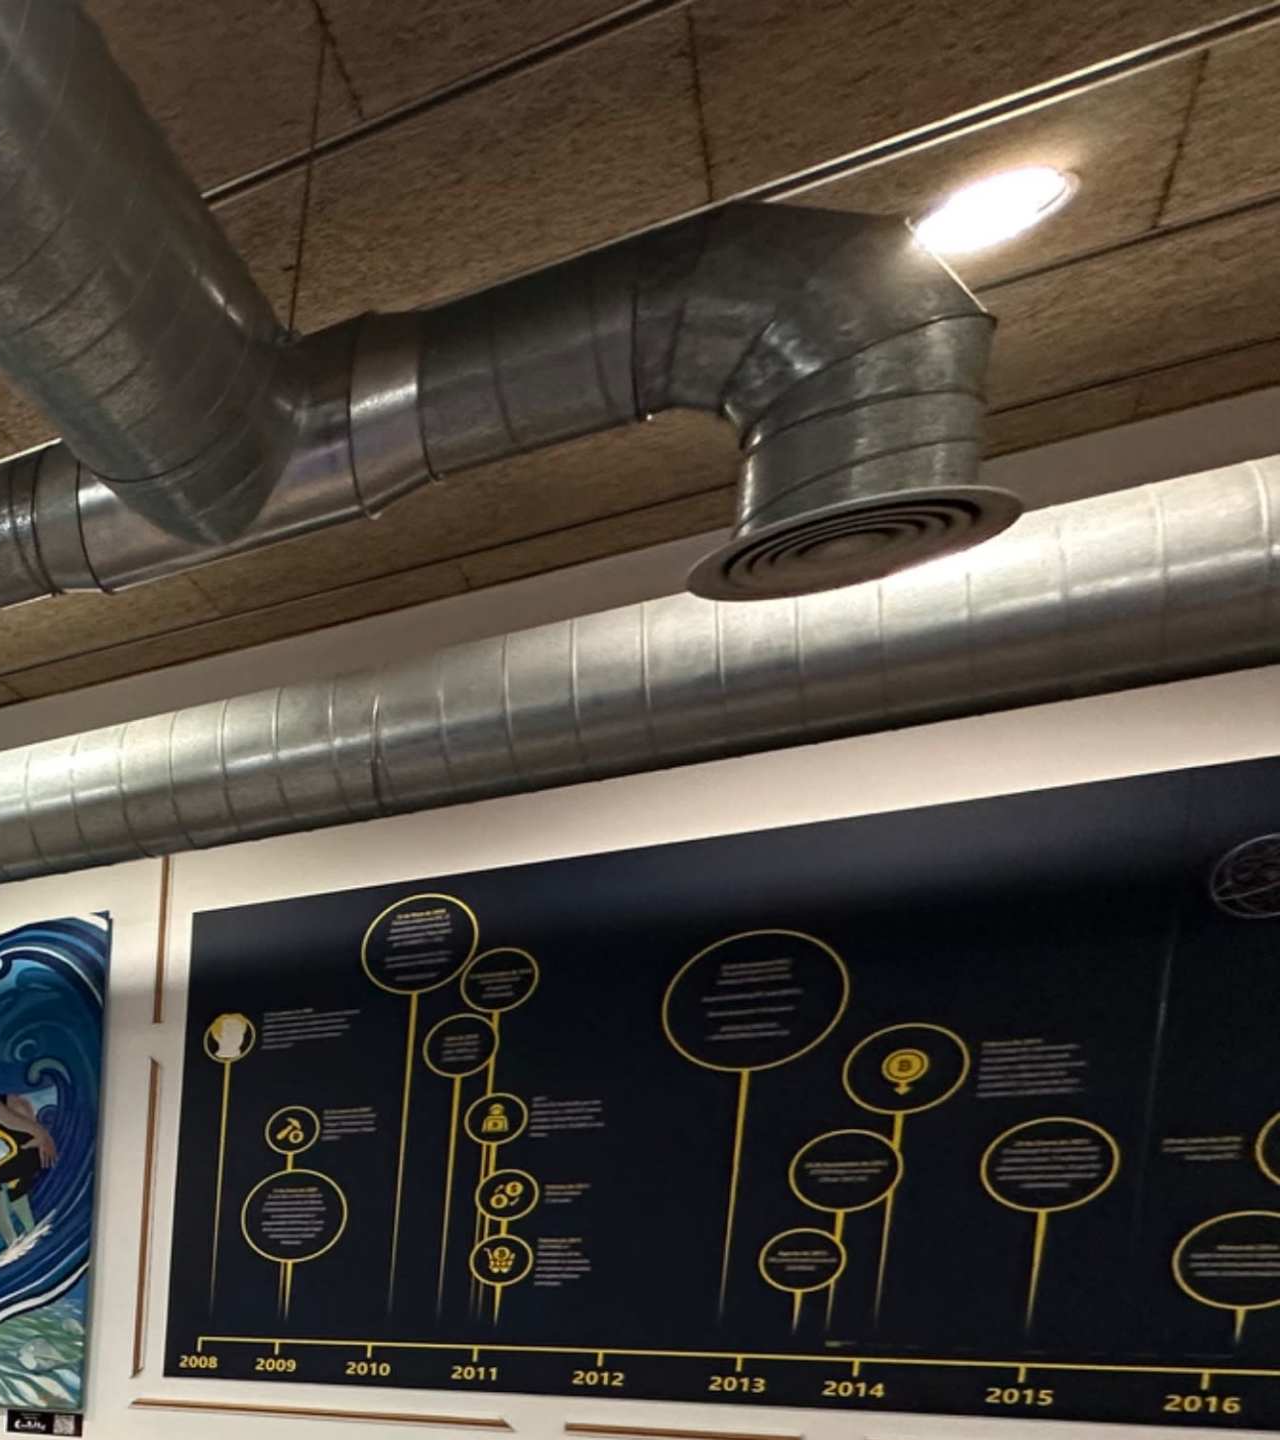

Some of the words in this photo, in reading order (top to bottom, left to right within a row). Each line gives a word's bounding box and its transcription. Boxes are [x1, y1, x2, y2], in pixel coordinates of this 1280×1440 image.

[179, 1355, 219, 1369] 2008
[255, 1357, 296, 1372] 2009
[345, 1361, 390, 1376] 2010
[451, 1365, 498, 1381] 2011
[572, 1370, 625, 1387] 2012
[708, 1376, 766, 1393] 2013
[822, 1381, 885, 1399] 2014
[985, 1387, 1054, 1406] 2015
[1163, 1395, 1241, 1414] 2016
